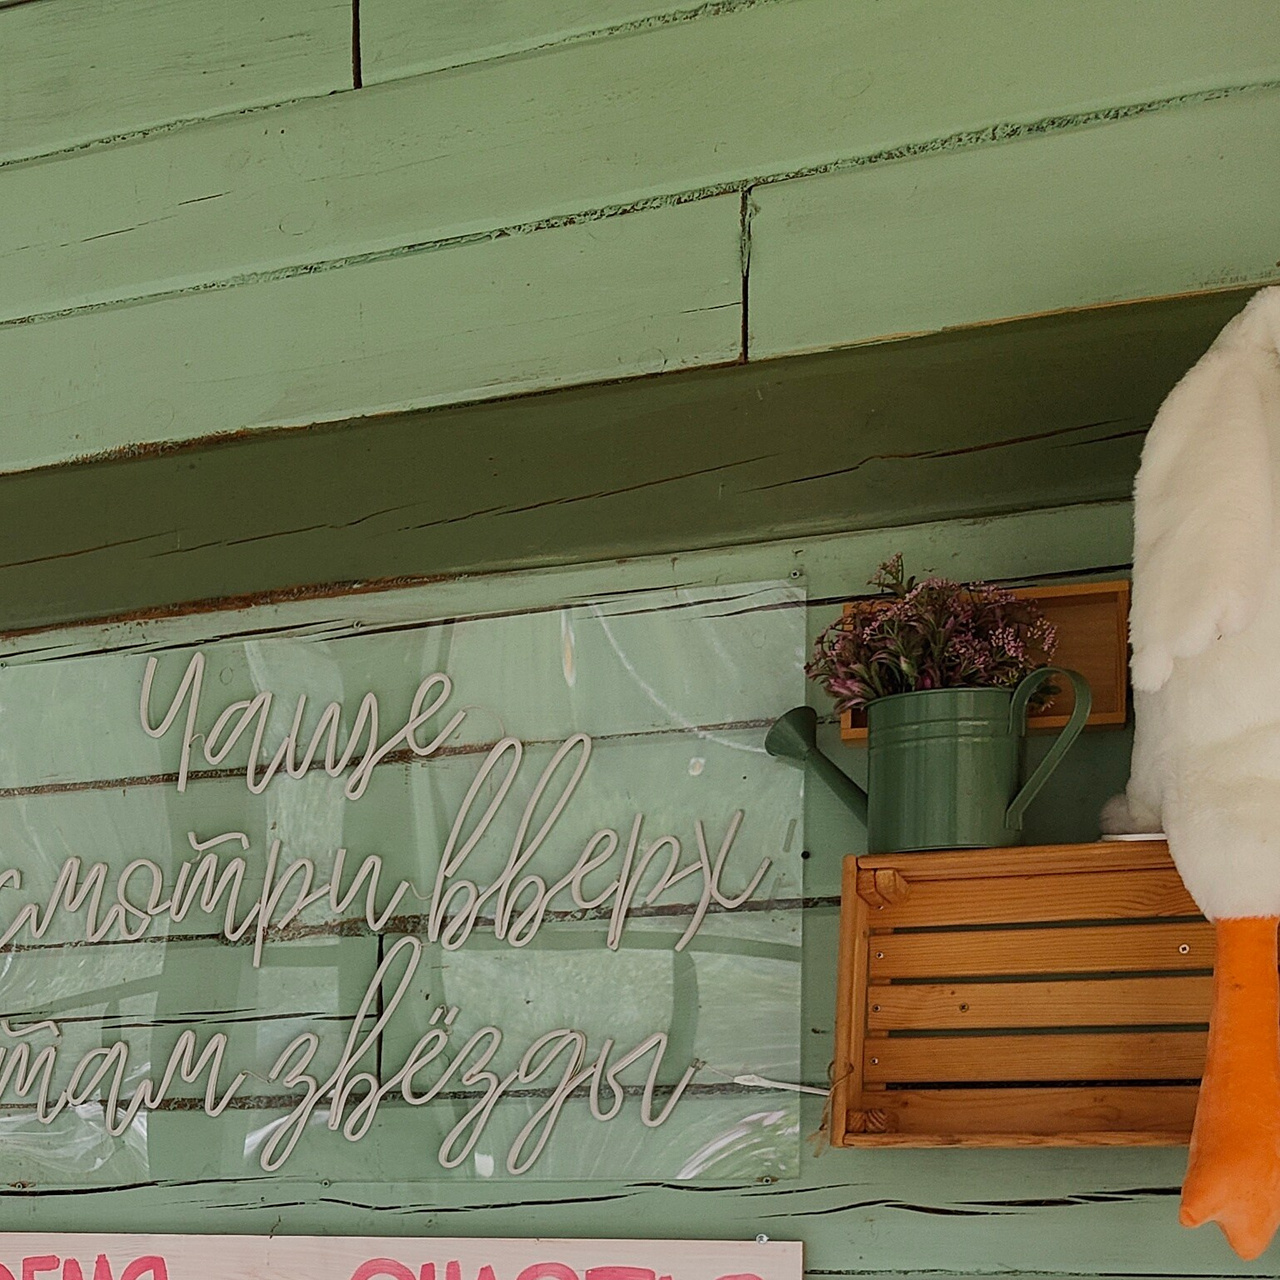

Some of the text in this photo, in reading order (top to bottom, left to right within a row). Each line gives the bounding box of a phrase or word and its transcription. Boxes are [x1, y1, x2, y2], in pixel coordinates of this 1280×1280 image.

[139, 652, 466, 800] Чаще
[428, 733, 772, 952] вверх
[260, 936, 704, 1175] звёзды
